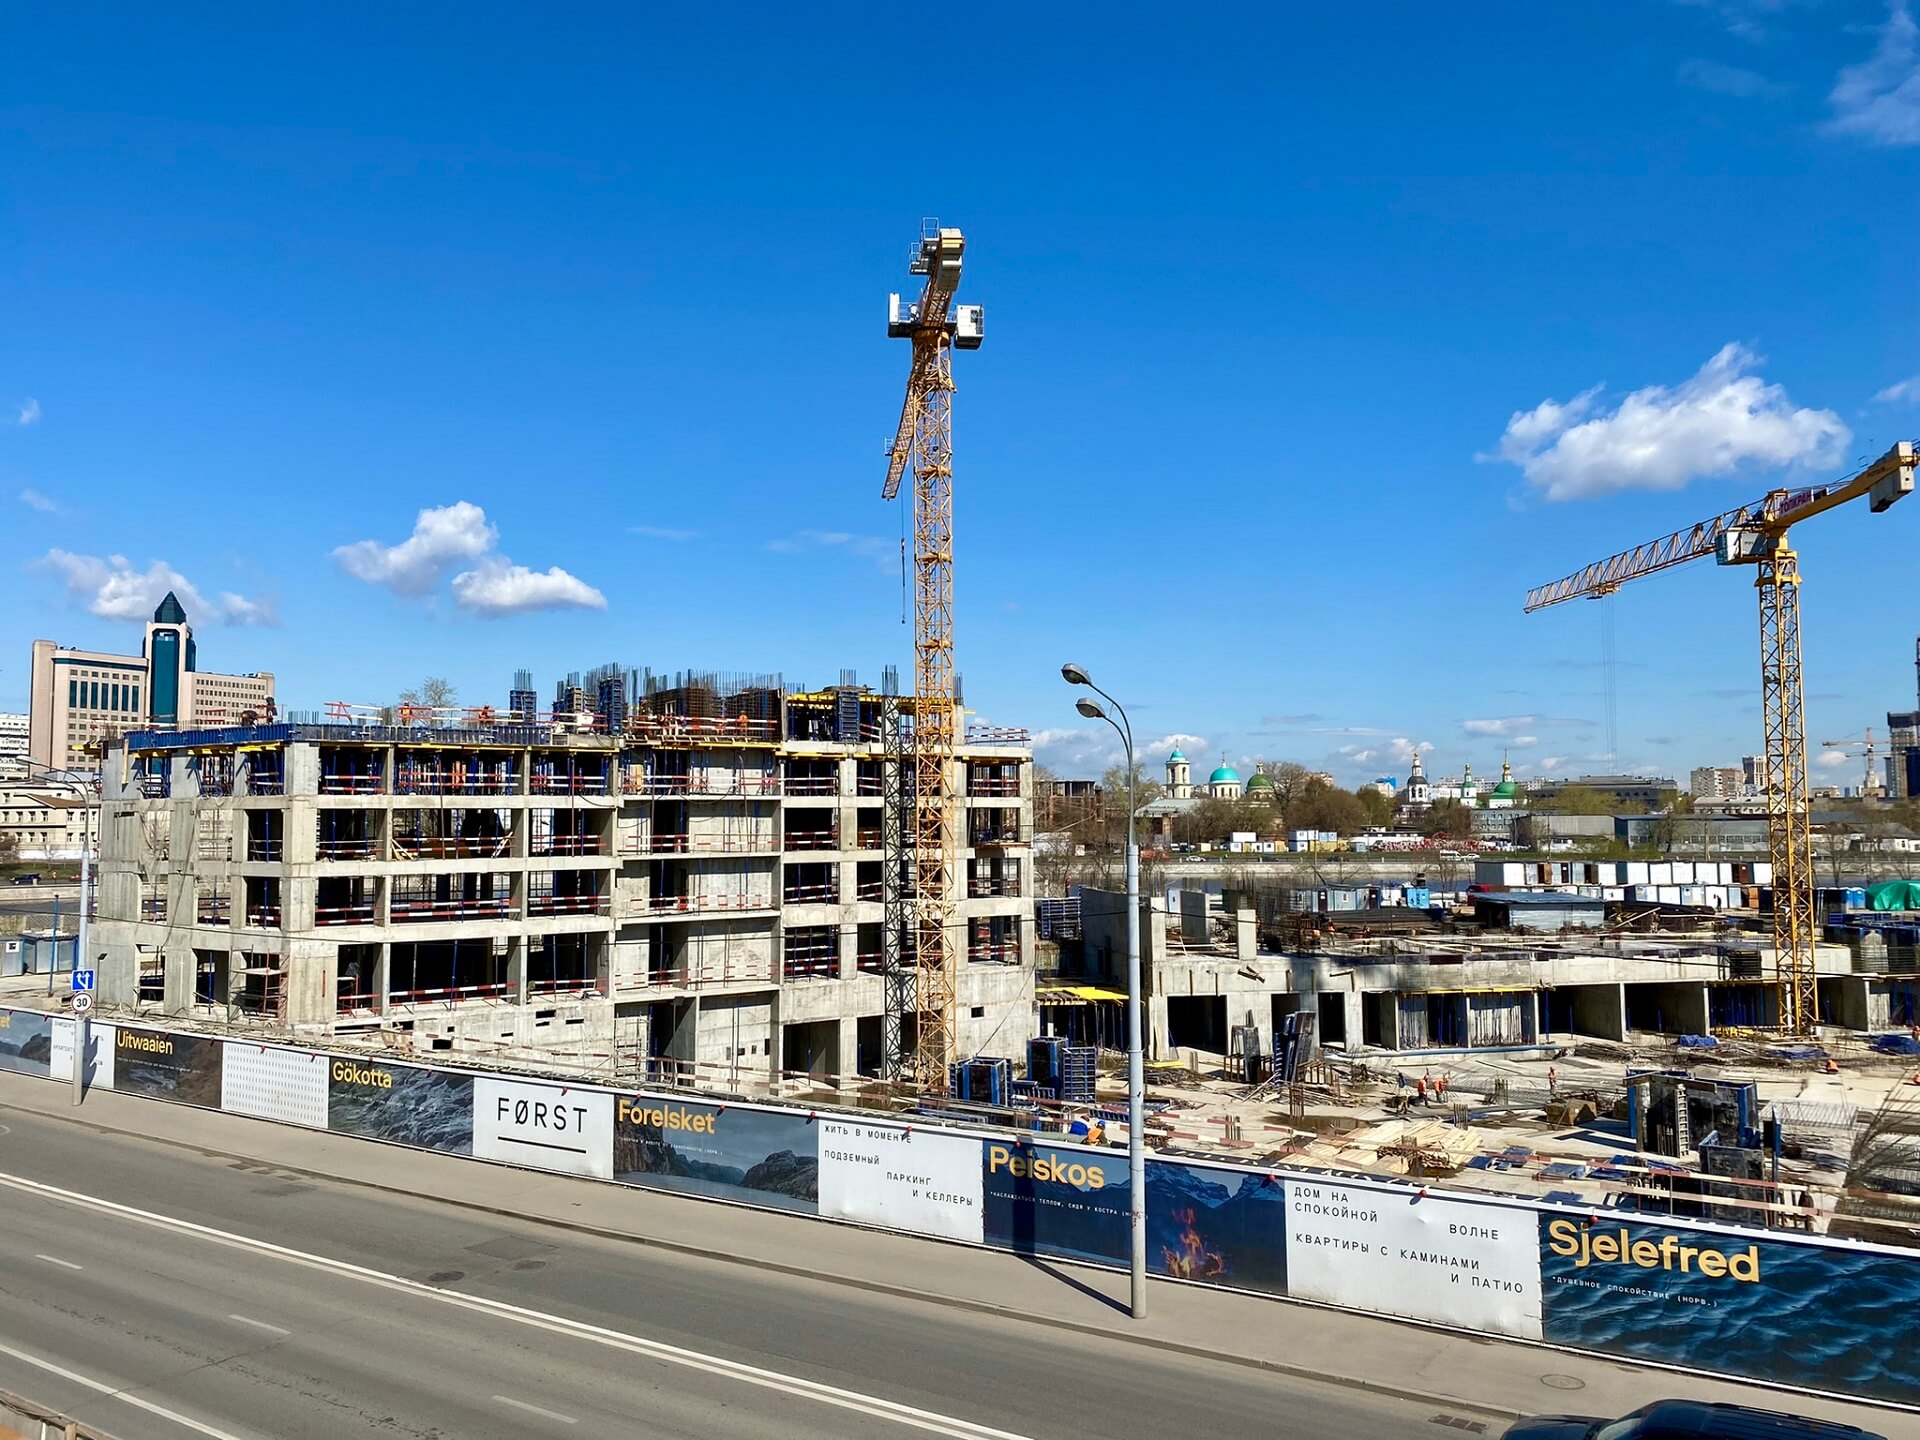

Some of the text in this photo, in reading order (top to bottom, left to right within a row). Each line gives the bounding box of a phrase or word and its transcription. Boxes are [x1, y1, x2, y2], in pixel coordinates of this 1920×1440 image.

[76, 997, 88, 1008] 30
[117, 1030, 173, 1055] Uitwaaien
[332, 1061, 392, 1089] Gökotta
[497, 1096, 588, 1134] FØRST
[618, 1100, 716, 1135] Forelsket
[824, 1124, 912, 1144] ЖИТЬ В МОМЕНТЕ
[824, 1149, 880, 1165] ПОДЗЕМНЫЙ
[990, 1146, 1105, 1189] Peiskos
[886, 1171, 932, 1186] ПАРКИНГ
[912, 1189, 973, 1206] И КЕЛЛЕРЫ
[1294, 1186, 1349, 1203] ДОМ НА
[1094, 1207, 1118, 1216] КОСТРА
[1294, 1202, 1378, 1223] СПОКОЙНОЙ
[1449, 1223, 1499, 1240] ВОЛНЕ
[1295, 1232, 1480, 1270] КВАРТИРЫ С КАМИНАМИ
[1548, 1219, 1760, 1283] Sjelefred
[1450, 1273, 1523, 1294] И ПАТИО
[1607, 1284, 1670, 1300] СПОКОЙСТВИЕ
[1677, 1295, 1718, 1308] (НОРВ.)
